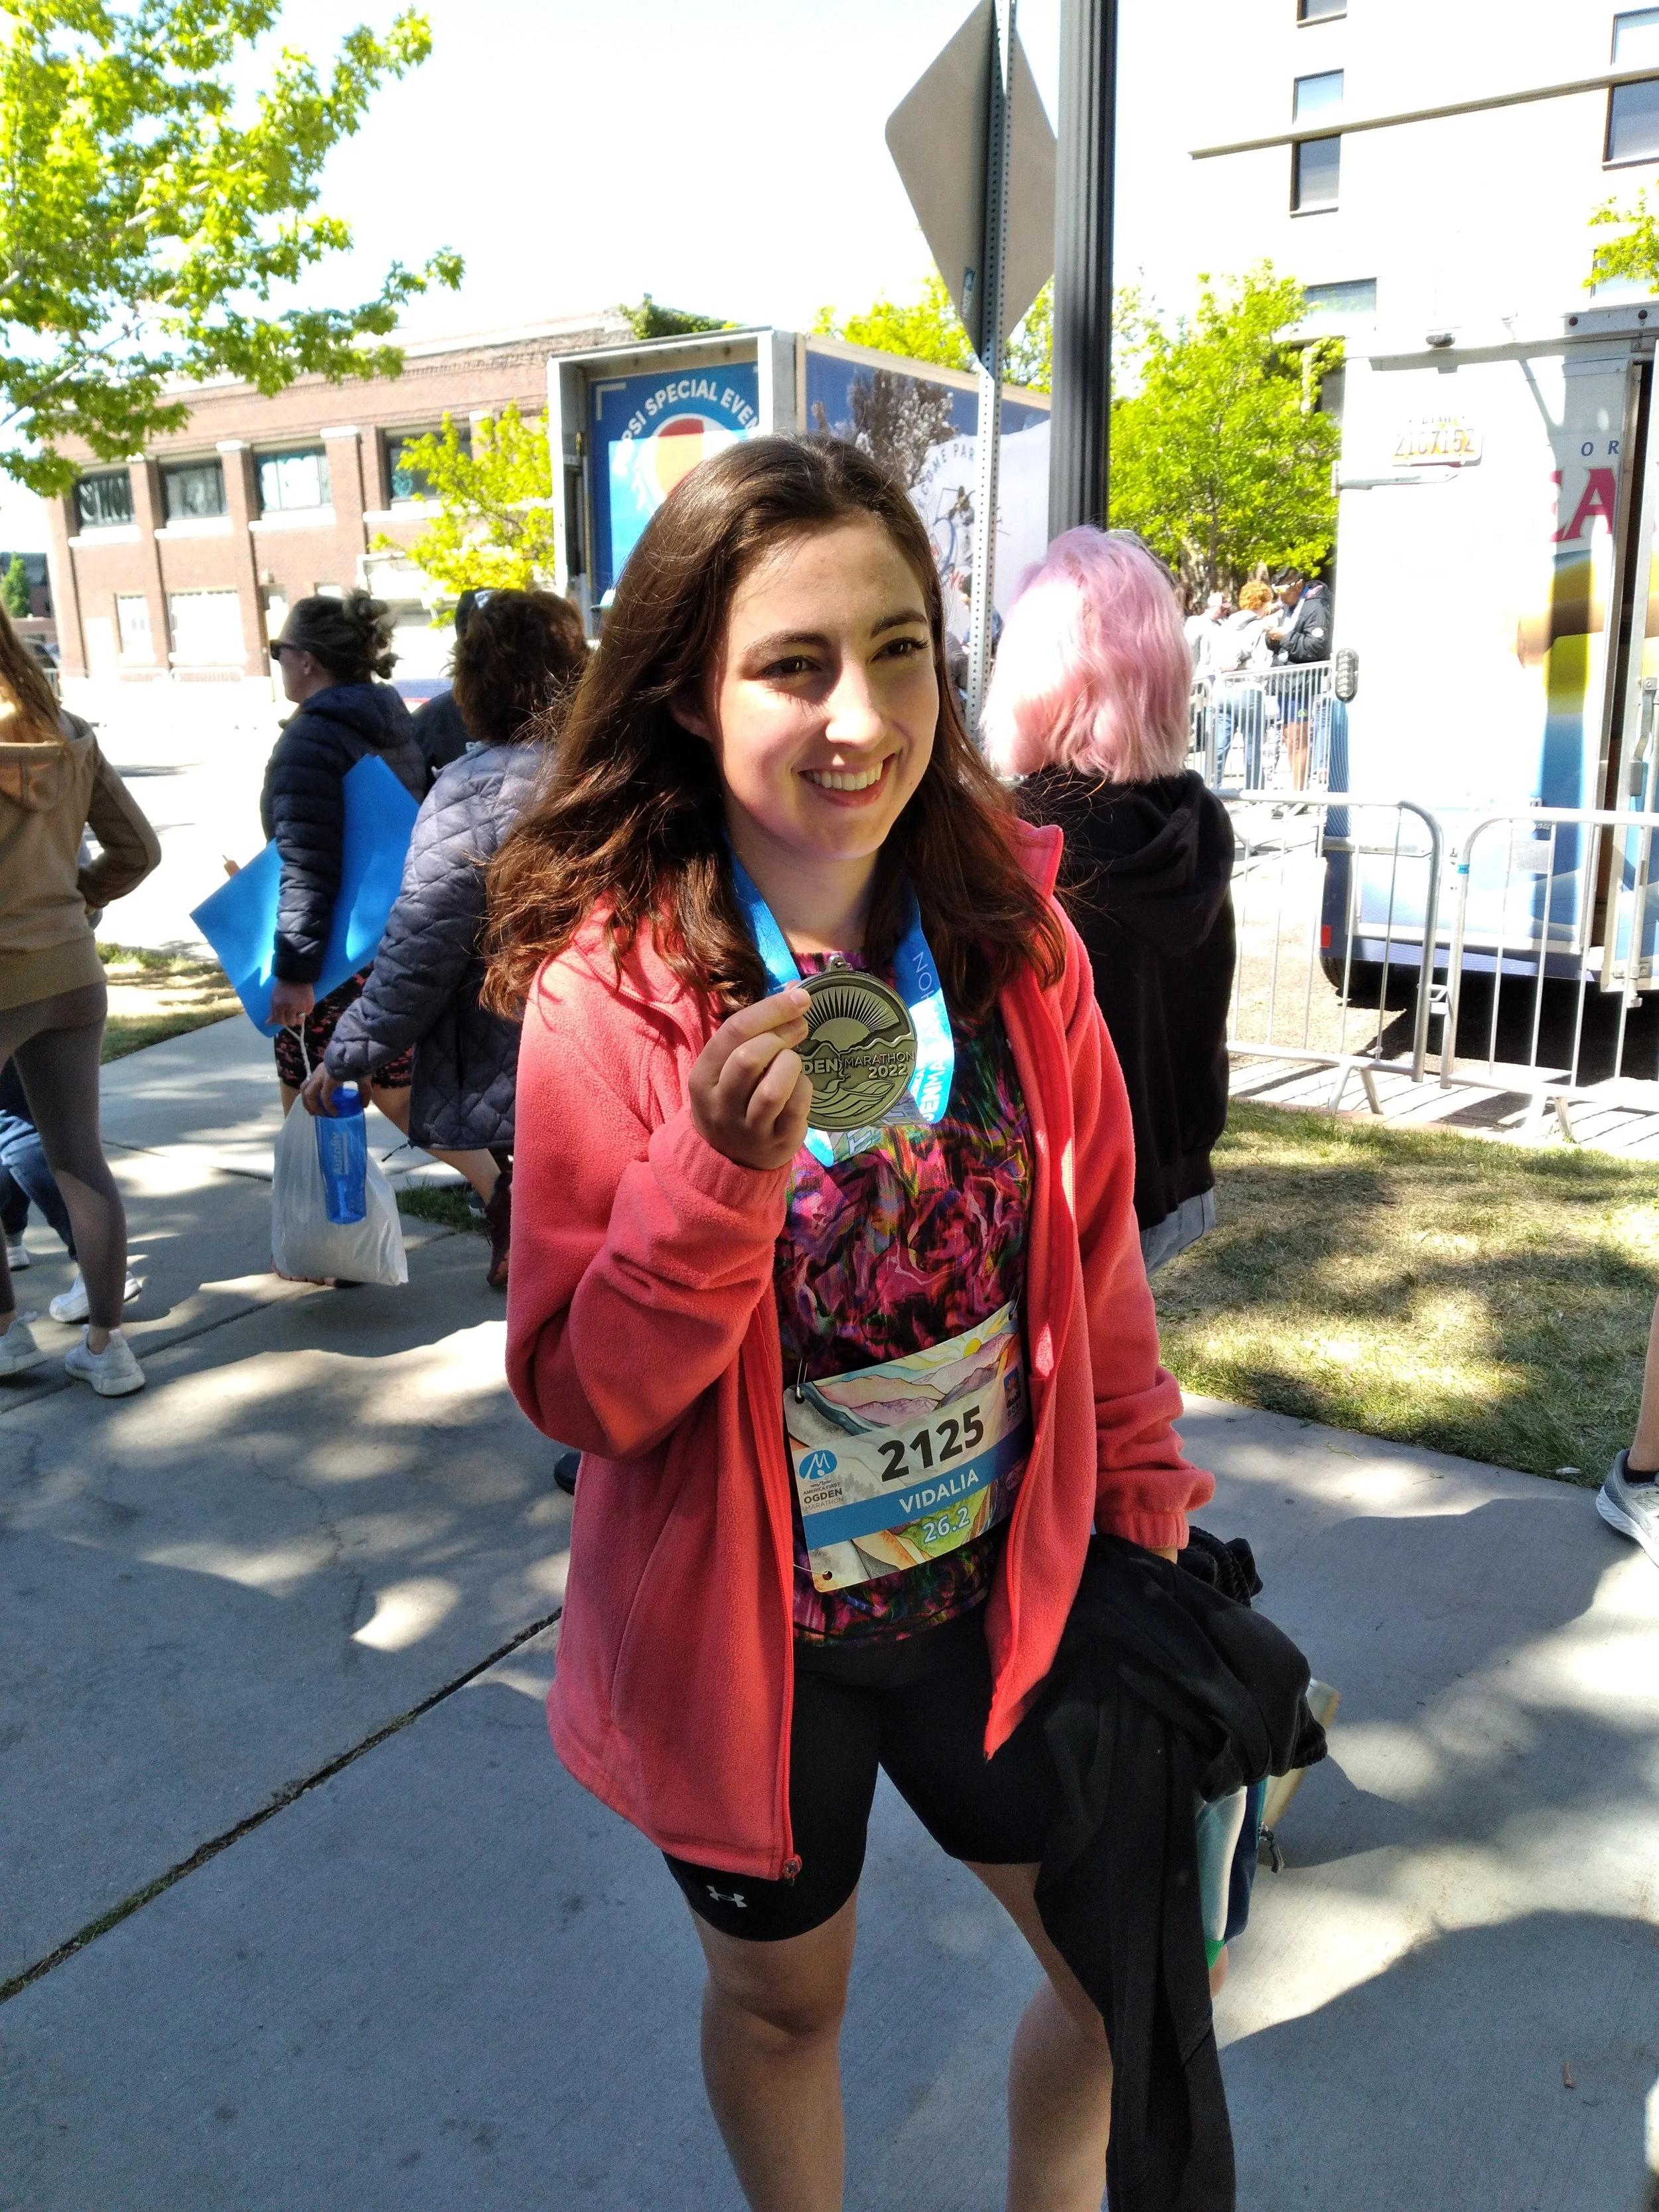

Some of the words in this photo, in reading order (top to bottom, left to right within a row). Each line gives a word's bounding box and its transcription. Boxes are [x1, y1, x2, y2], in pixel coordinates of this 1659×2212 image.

[644, 379, 717, 416] SPECIAL
[918, 449, 948, 503] COME
[844, 1051, 915, 1068] MARATHON
[868, 1063, 908, 1079] 2022
[877, 1404, 984, 1483] 2125
[803, 1486, 825, 1496] AMERICA
[826, 1481, 841, 1491] FIRST
[804, 1487, 843, 1505] OGDEN
[899, 1468, 979, 1514] VIDALIA
[804, 1497, 844, 1511] MARATHON
[922, 1506, 970, 1544] 26.2
